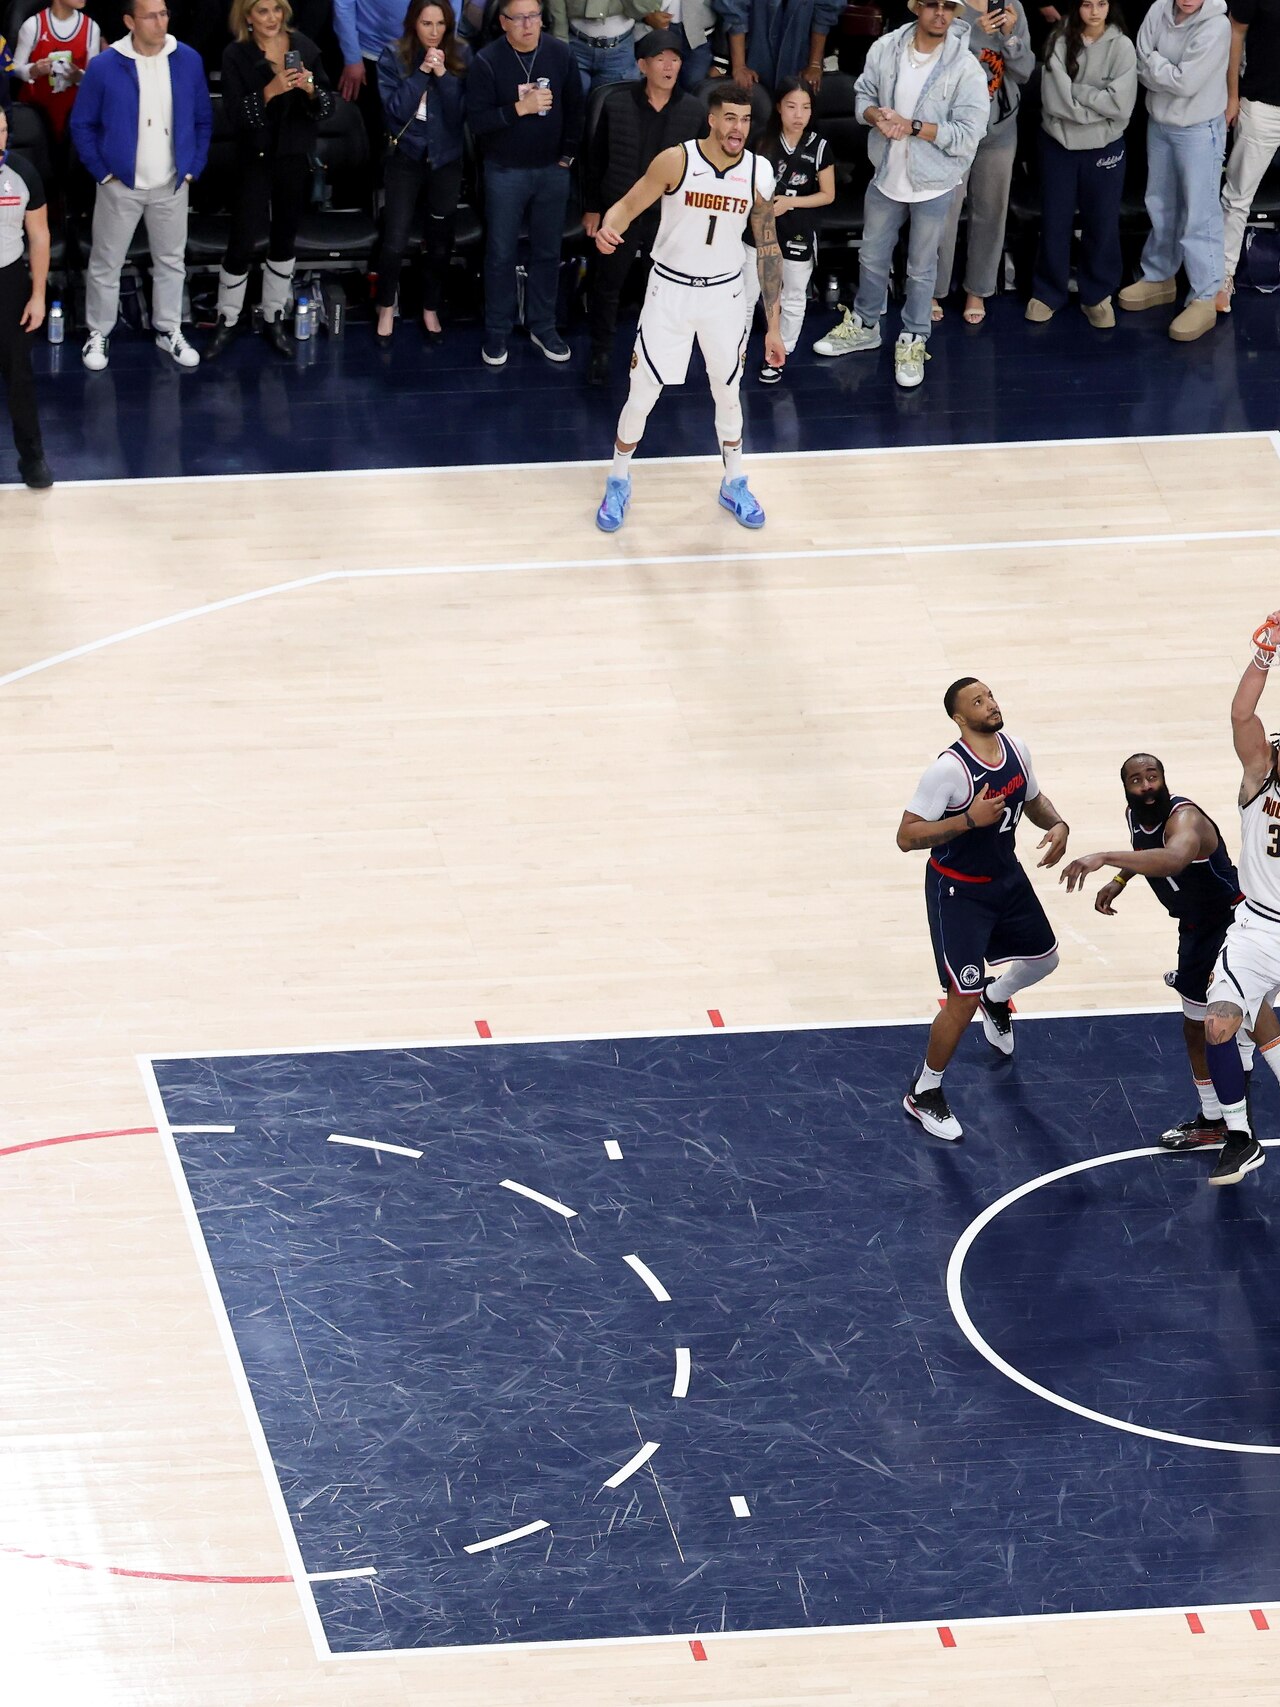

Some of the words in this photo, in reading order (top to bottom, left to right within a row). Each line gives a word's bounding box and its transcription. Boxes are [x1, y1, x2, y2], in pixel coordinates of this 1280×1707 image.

[684, 190, 748, 214] NUGGETS
[705, 215, 718, 246] 1
[999, 800, 1024, 834] 24
